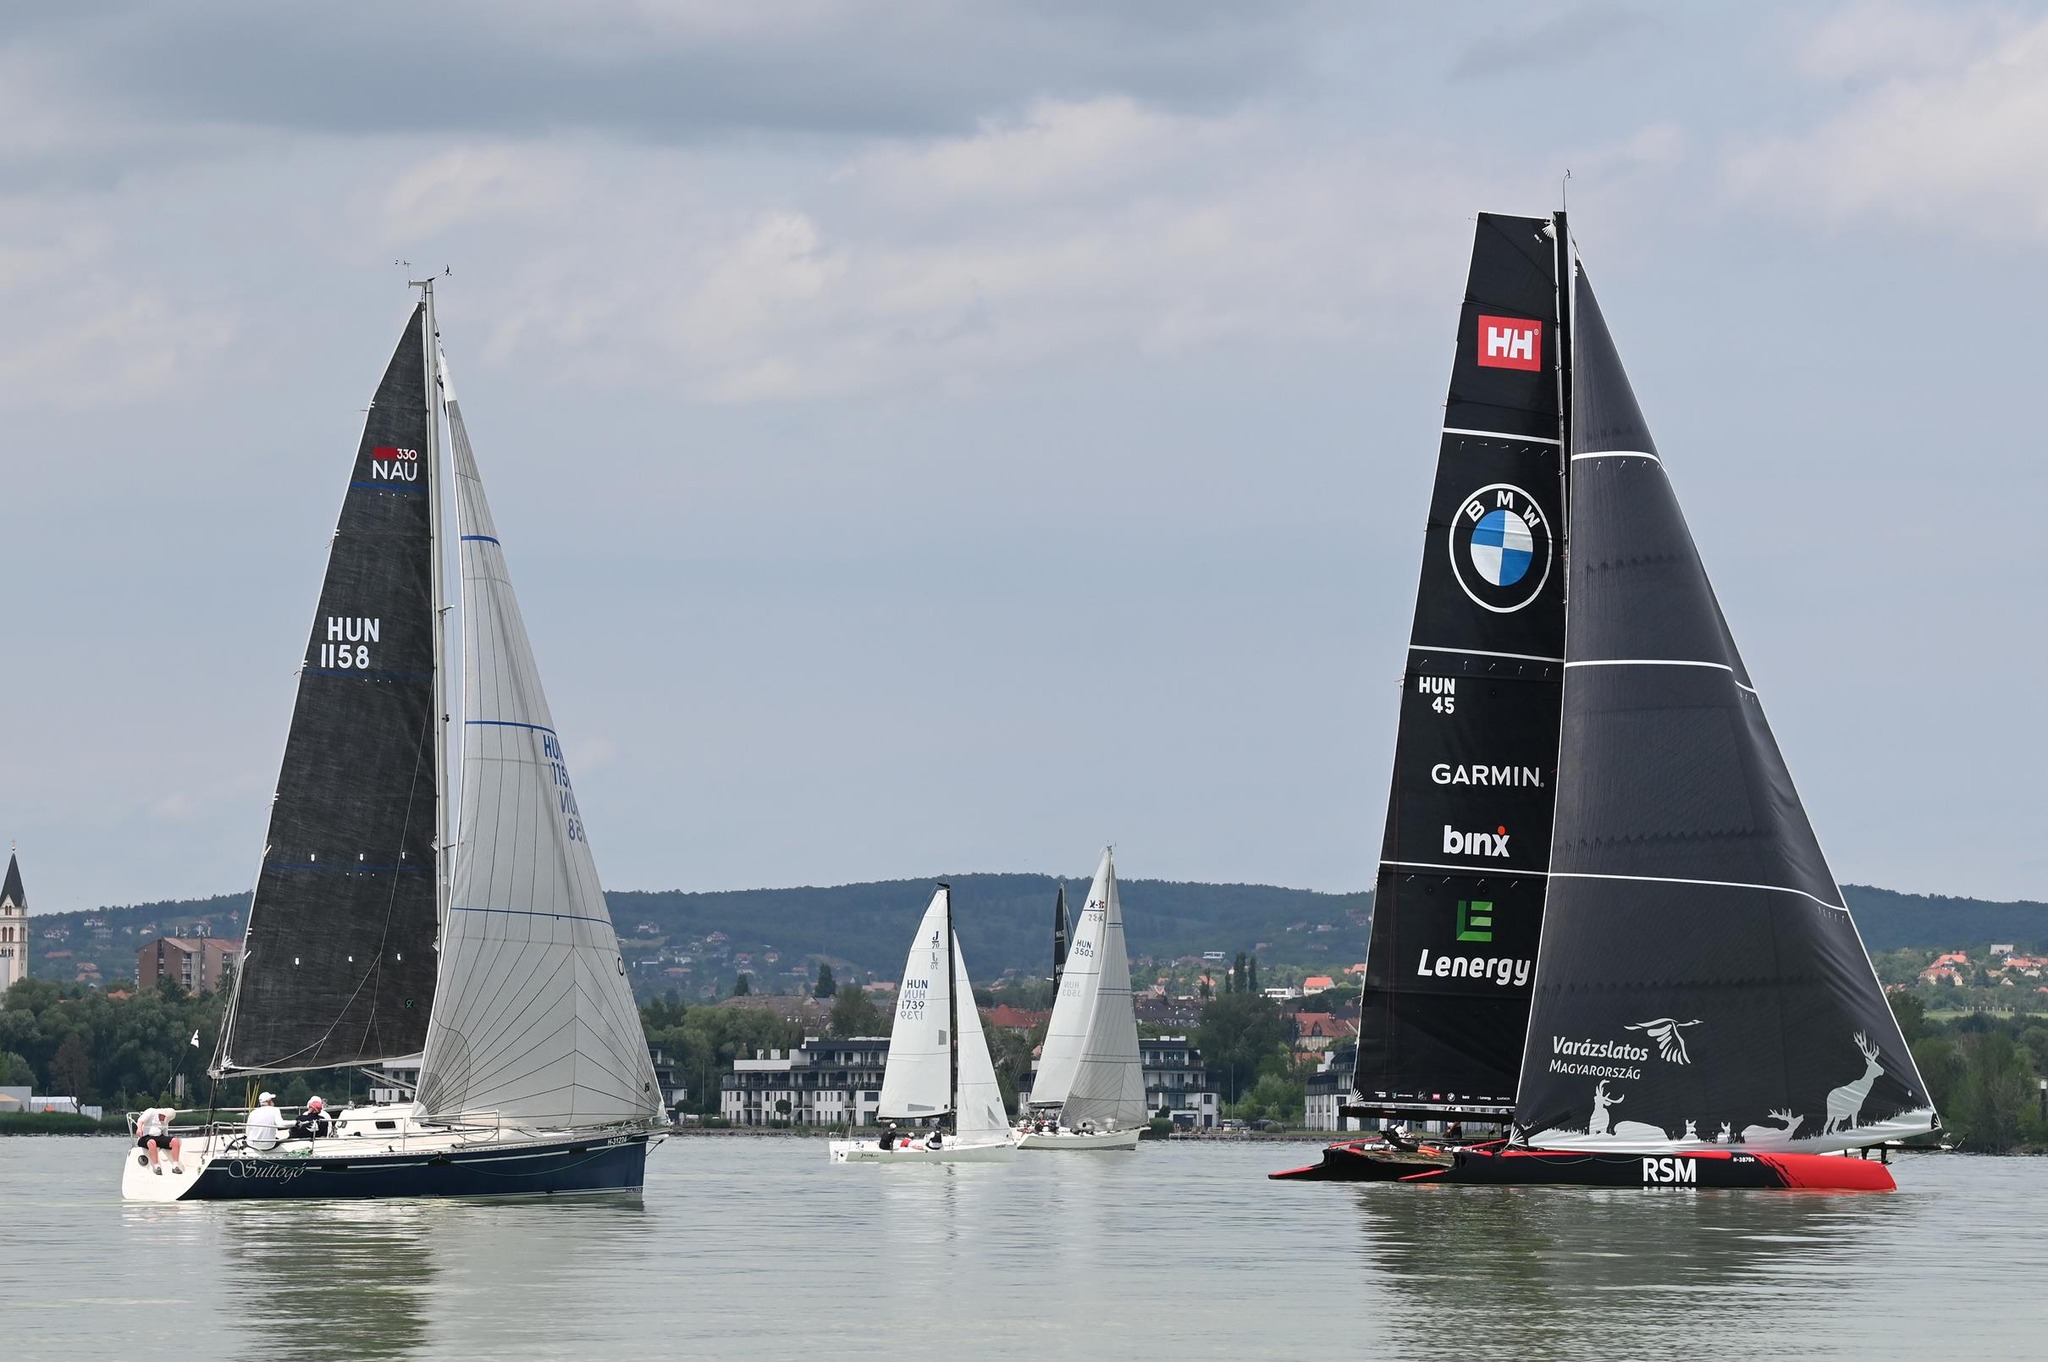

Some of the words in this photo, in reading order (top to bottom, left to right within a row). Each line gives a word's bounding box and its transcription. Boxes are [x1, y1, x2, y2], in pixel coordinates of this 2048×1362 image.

[1487, 326, 1533, 361] HH
[396, 448, 418, 460] 330
[372, 460, 418, 481] NAU
[1465, 490, 1541, 527] BMW
[327, 616, 380, 642] HUN
[320, 643, 370, 669] 1158
[1418, 677, 1456, 695] HUN
[1431, 696, 1455, 715] 45
[1431, 763, 1541, 787] GARMIN
[932, 931, 939, 941] J
[1076, 939, 1092, 950] HUN
[1074, 947, 1094, 958] 3503
[1417, 949, 1531, 986] Lenergy
[907, 980, 928, 989] HUN
[902, 1000, 925, 1010] 1739
[1552, 1036, 1650, 1062] Varázslatos
[1549, 1059, 1641, 1080] MAGYARORSZÁG
[1642, 1157, 1697, 1183] RSM
